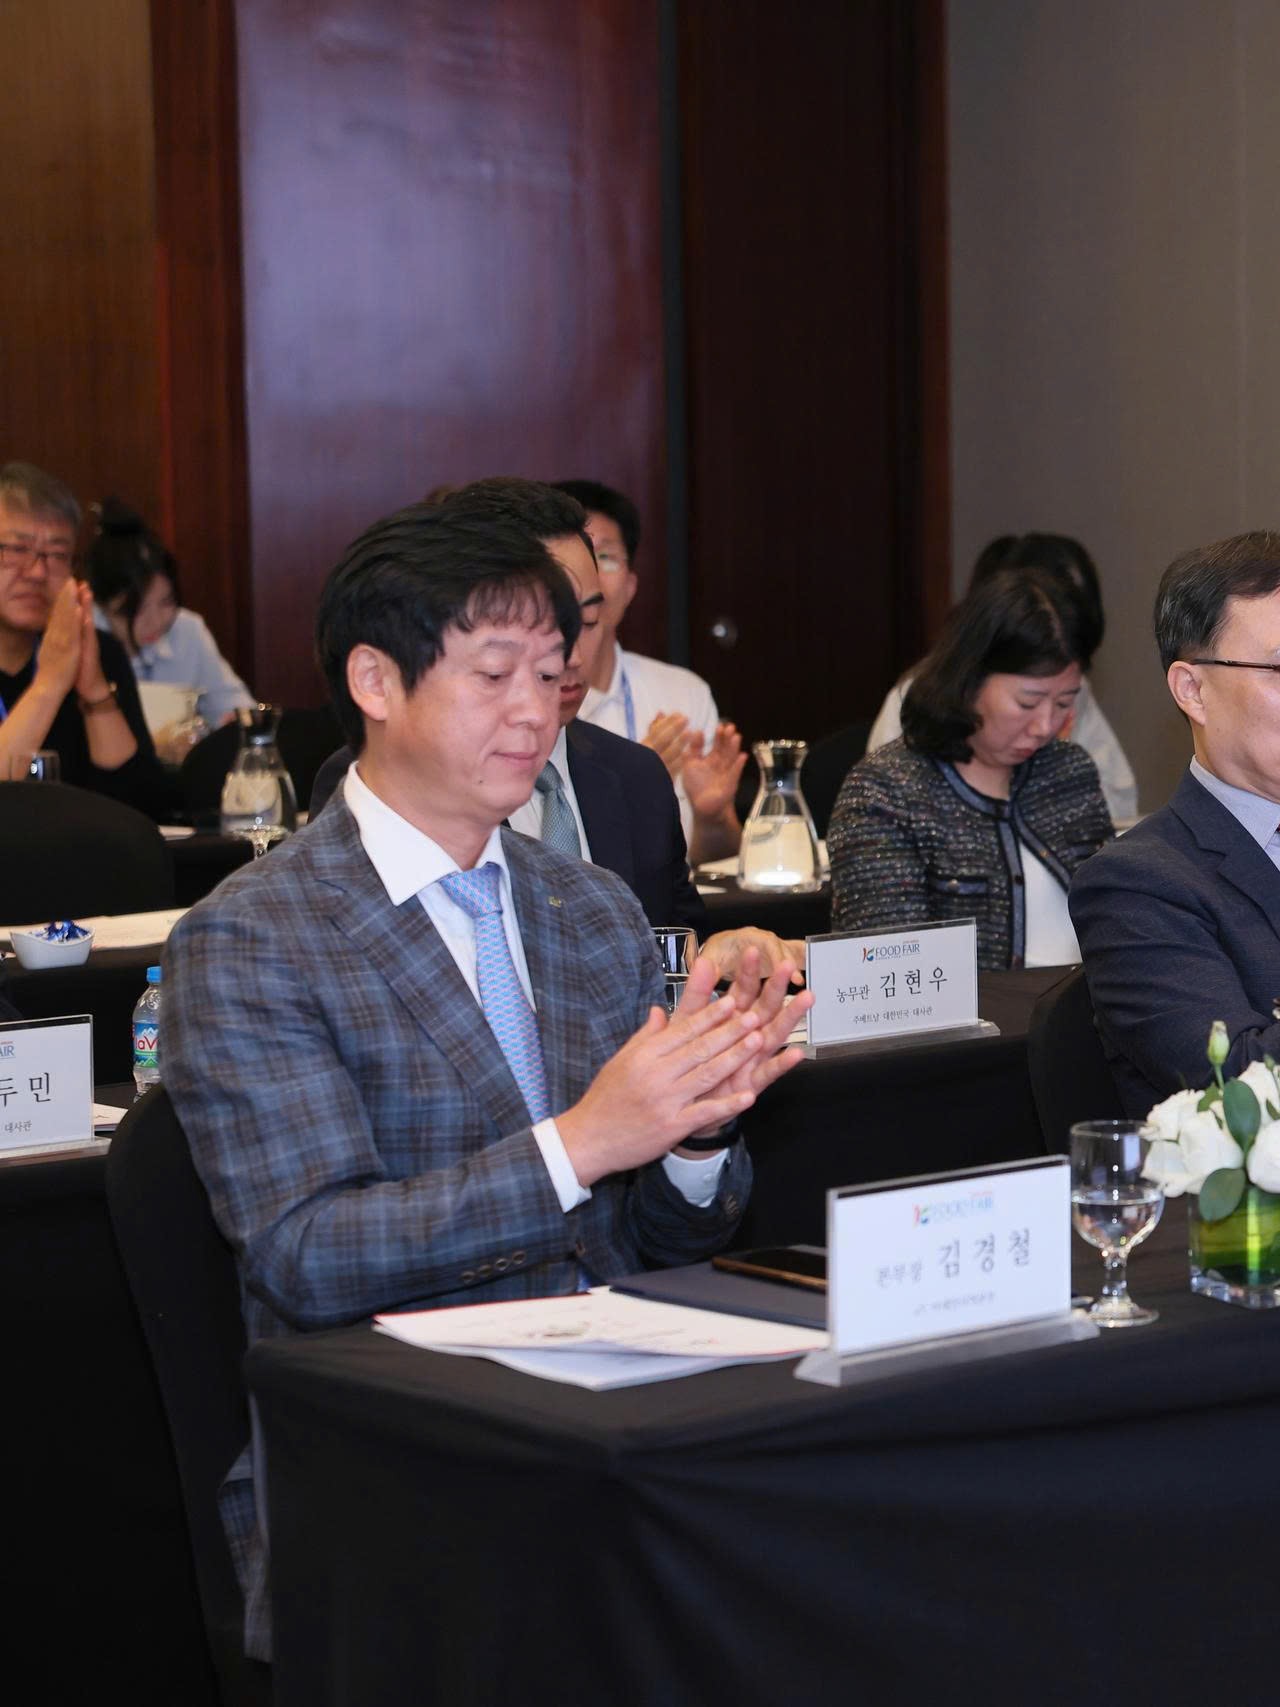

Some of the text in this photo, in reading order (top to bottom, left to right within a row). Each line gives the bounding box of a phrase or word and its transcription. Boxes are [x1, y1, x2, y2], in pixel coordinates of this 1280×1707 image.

[876, 945, 901, 958] FOOD
[902, 943, 920, 954] FAIR
[836, 984, 871, 1004] 농무관
[853, 1006, 933, 1025] 주베트남 대한민국 대사관
[4, 1120, 32, 1133] 대사관
